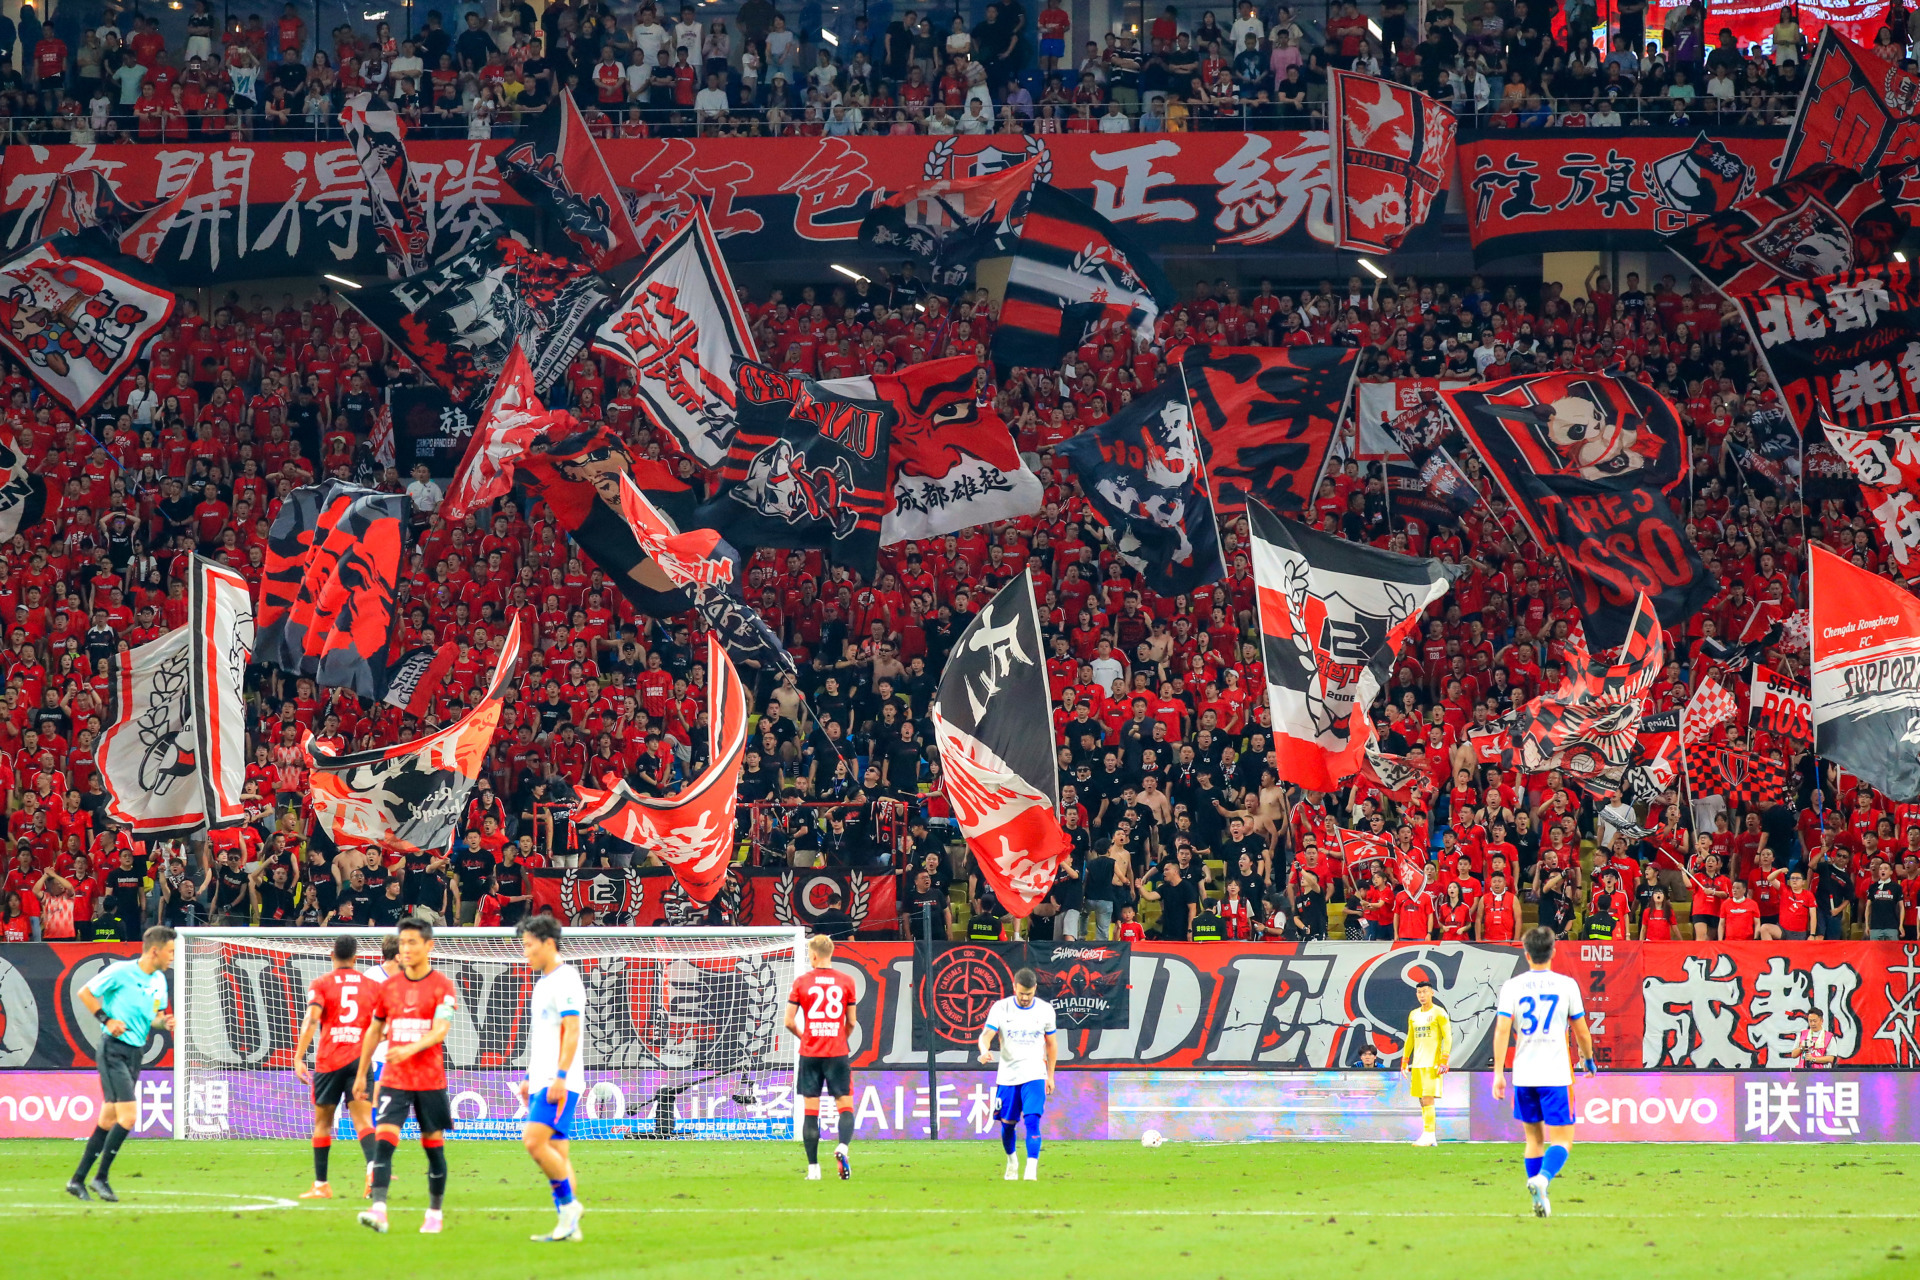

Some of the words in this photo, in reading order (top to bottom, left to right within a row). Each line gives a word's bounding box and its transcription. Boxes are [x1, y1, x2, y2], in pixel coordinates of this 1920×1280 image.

[1349, 151, 1386, 171] THIS
[572, 294, 592, 321] WATER
[895, 466, 1017, 517] 成都雄起
[1823, 624, 1856, 639] Chengdu
[1859, 635, 1873, 648] FC
[1844, 655, 1920, 699] SUPPOR
[1580, 945, 1614, 962] ONE
[1590, 971, 1606, 992] Z
[339, 986, 358, 1023] 5
[807, 985, 843, 1019] 28
[1519, 994, 1559, 1035] 37
[1589, 1012, 1606, 1035] Z
[1592, 1047, 1612, 1062] NE
[378, 1096, 391, 1114] 7
[1745, 1082, 1861, 1136] 联想
